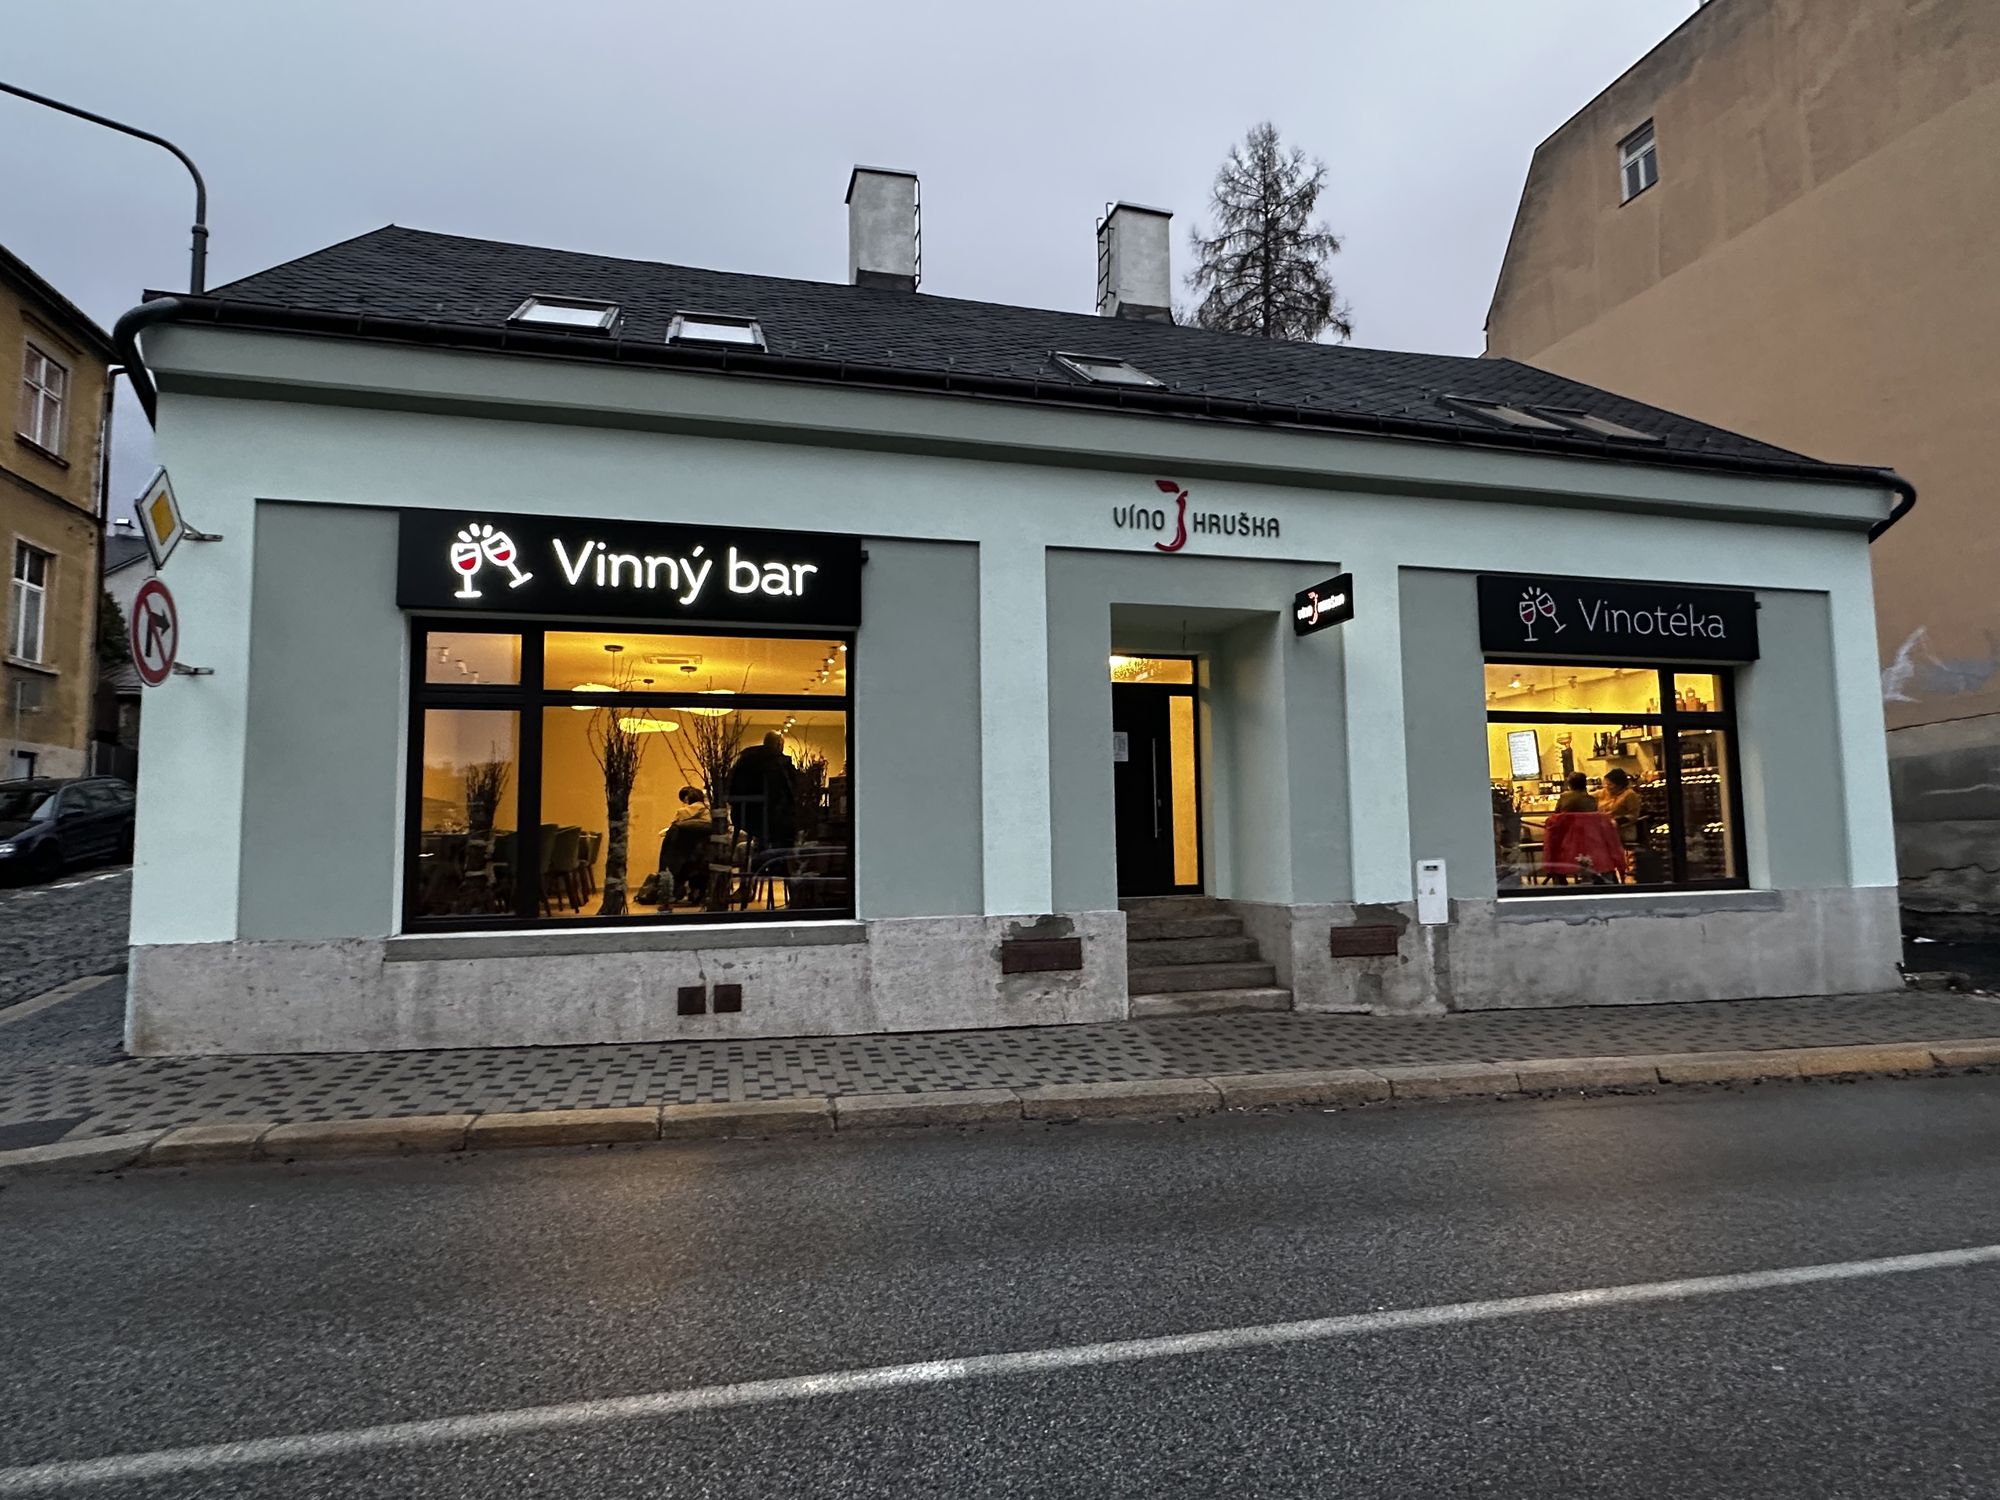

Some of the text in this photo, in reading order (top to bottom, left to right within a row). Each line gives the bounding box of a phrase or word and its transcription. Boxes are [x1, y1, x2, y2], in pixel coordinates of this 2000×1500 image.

[1193, 512, 1280, 538] HRUŠKA
[552, 538, 819, 605] Vinný bar
[1577, 598, 1726, 638] Vinotéka
